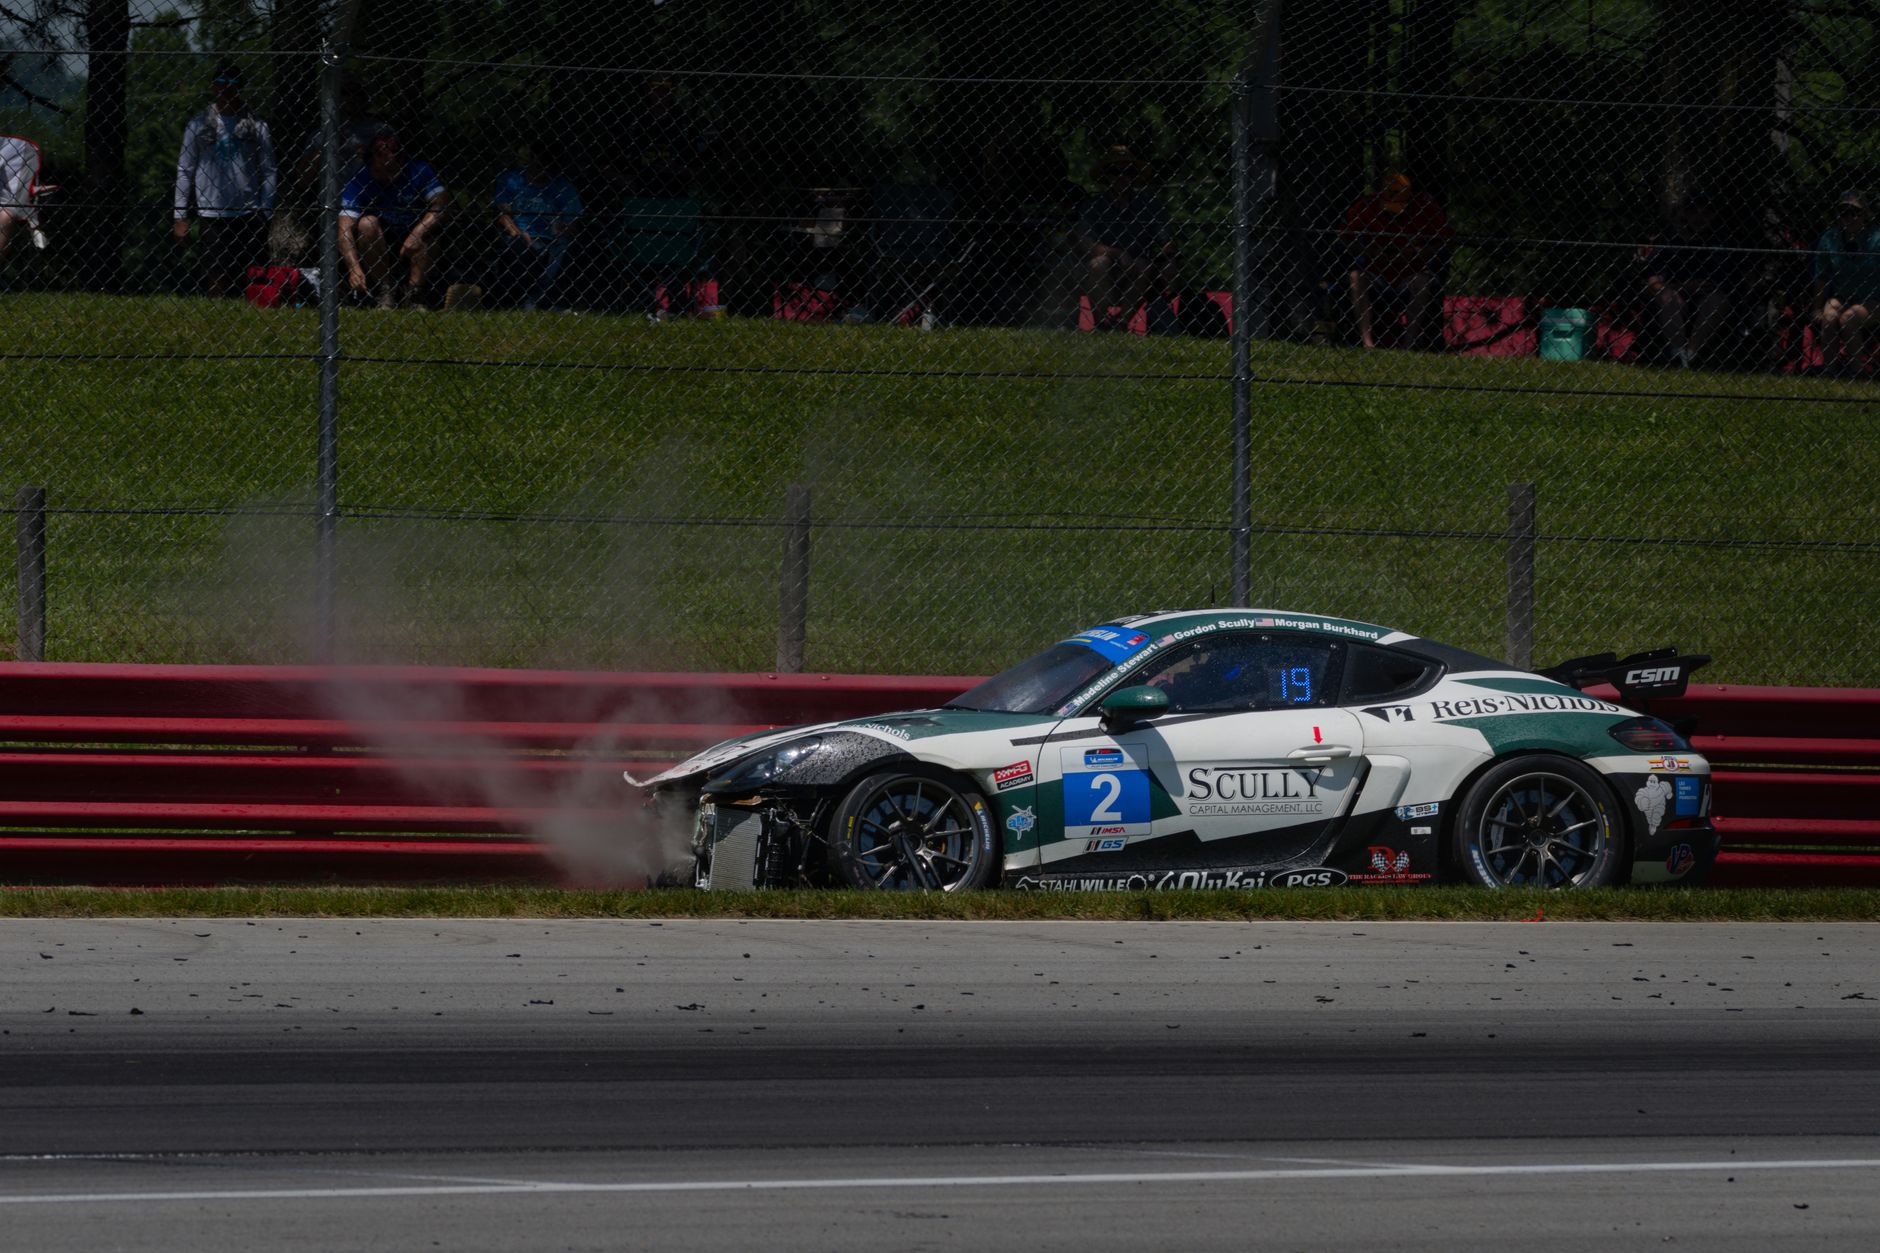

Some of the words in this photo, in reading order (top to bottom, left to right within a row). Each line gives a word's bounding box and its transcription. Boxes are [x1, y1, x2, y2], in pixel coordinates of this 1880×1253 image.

[1173, 623, 1216, 642] Gordon
[1218, 618, 1256, 632] Scully
[1274, 618, 1319, 633] Morgan
[1323, 623, 1379, 641] Burkhard
[1072, 672, 1119, 706] Madeline
[1117, 643, 1158, 674] Stewart
[1281, 667, 1311, 702] 19
[1000, 776, 1032, 789] ACADEMY
[1187, 766, 1326, 800] SCULLY
[1090, 773, 1122, 822] 2
[1189, 804, 1228, 814] CAPITAL
[1306, 803, 1323, 813] LLC
[979, 814, 991, 850] MICHELIN
[1101, 839, 1124, 849] GS
[1038, 878, 1127, 891] STAHLWILLE
[1287, 873, 1332, 887] PCS
